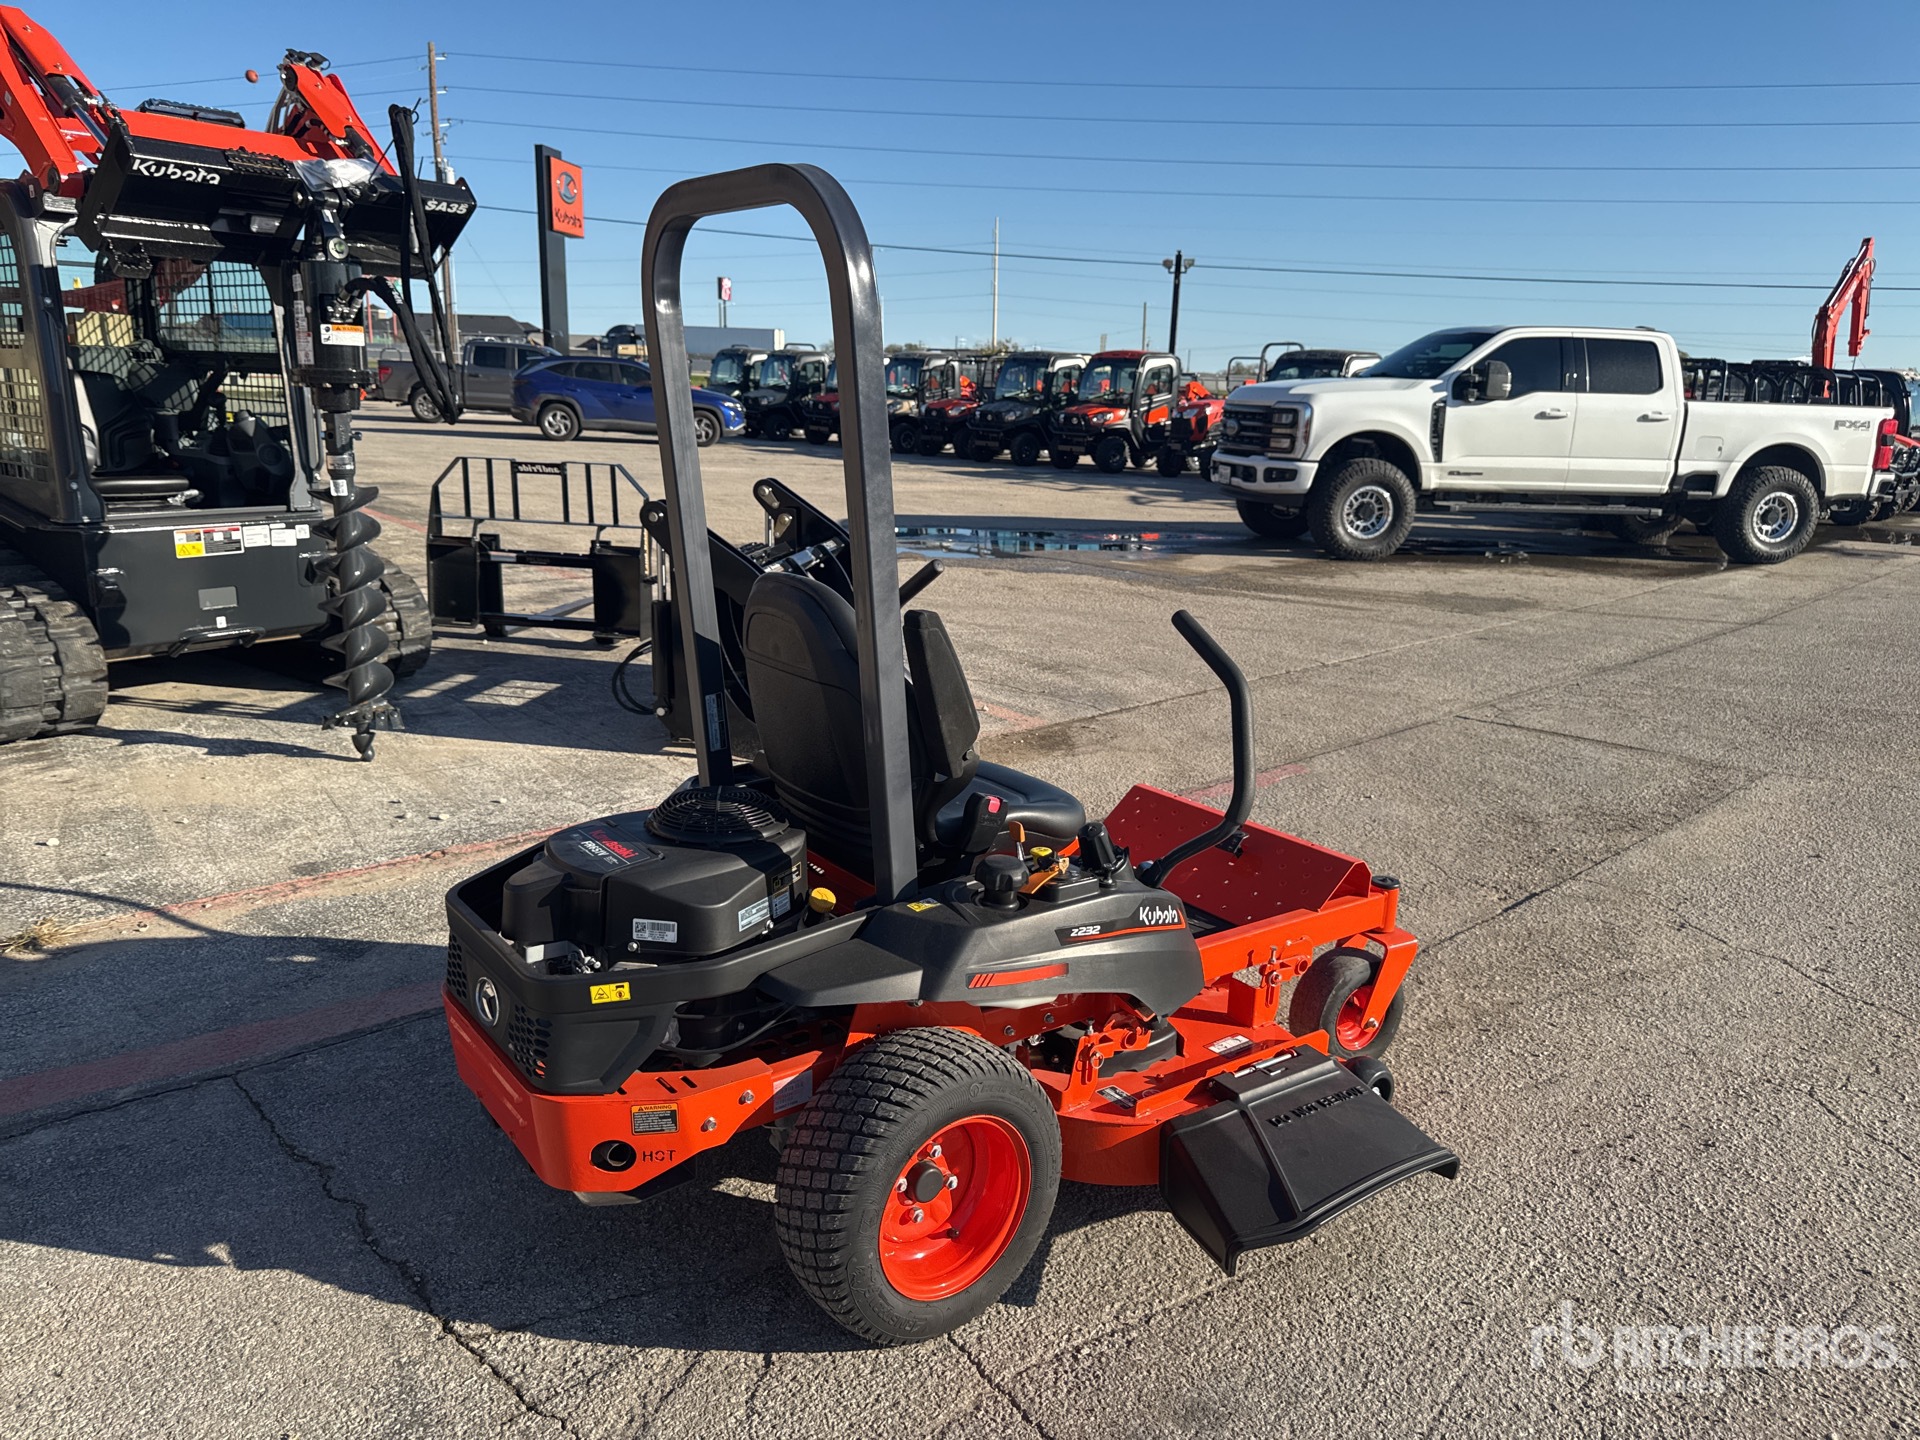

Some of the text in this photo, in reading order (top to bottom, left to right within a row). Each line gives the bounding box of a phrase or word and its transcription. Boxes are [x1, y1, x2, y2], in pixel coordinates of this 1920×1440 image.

[132, 159, 221, 185] Kubota
[425, 200, 469, 214] SA35
[555, 208, 582, 228] Kubota
[1834, 420, 1870, 430] FX4
[1140, 905, 1178, 925] Kubota
[642, 1150, 676, 1162] HOT
